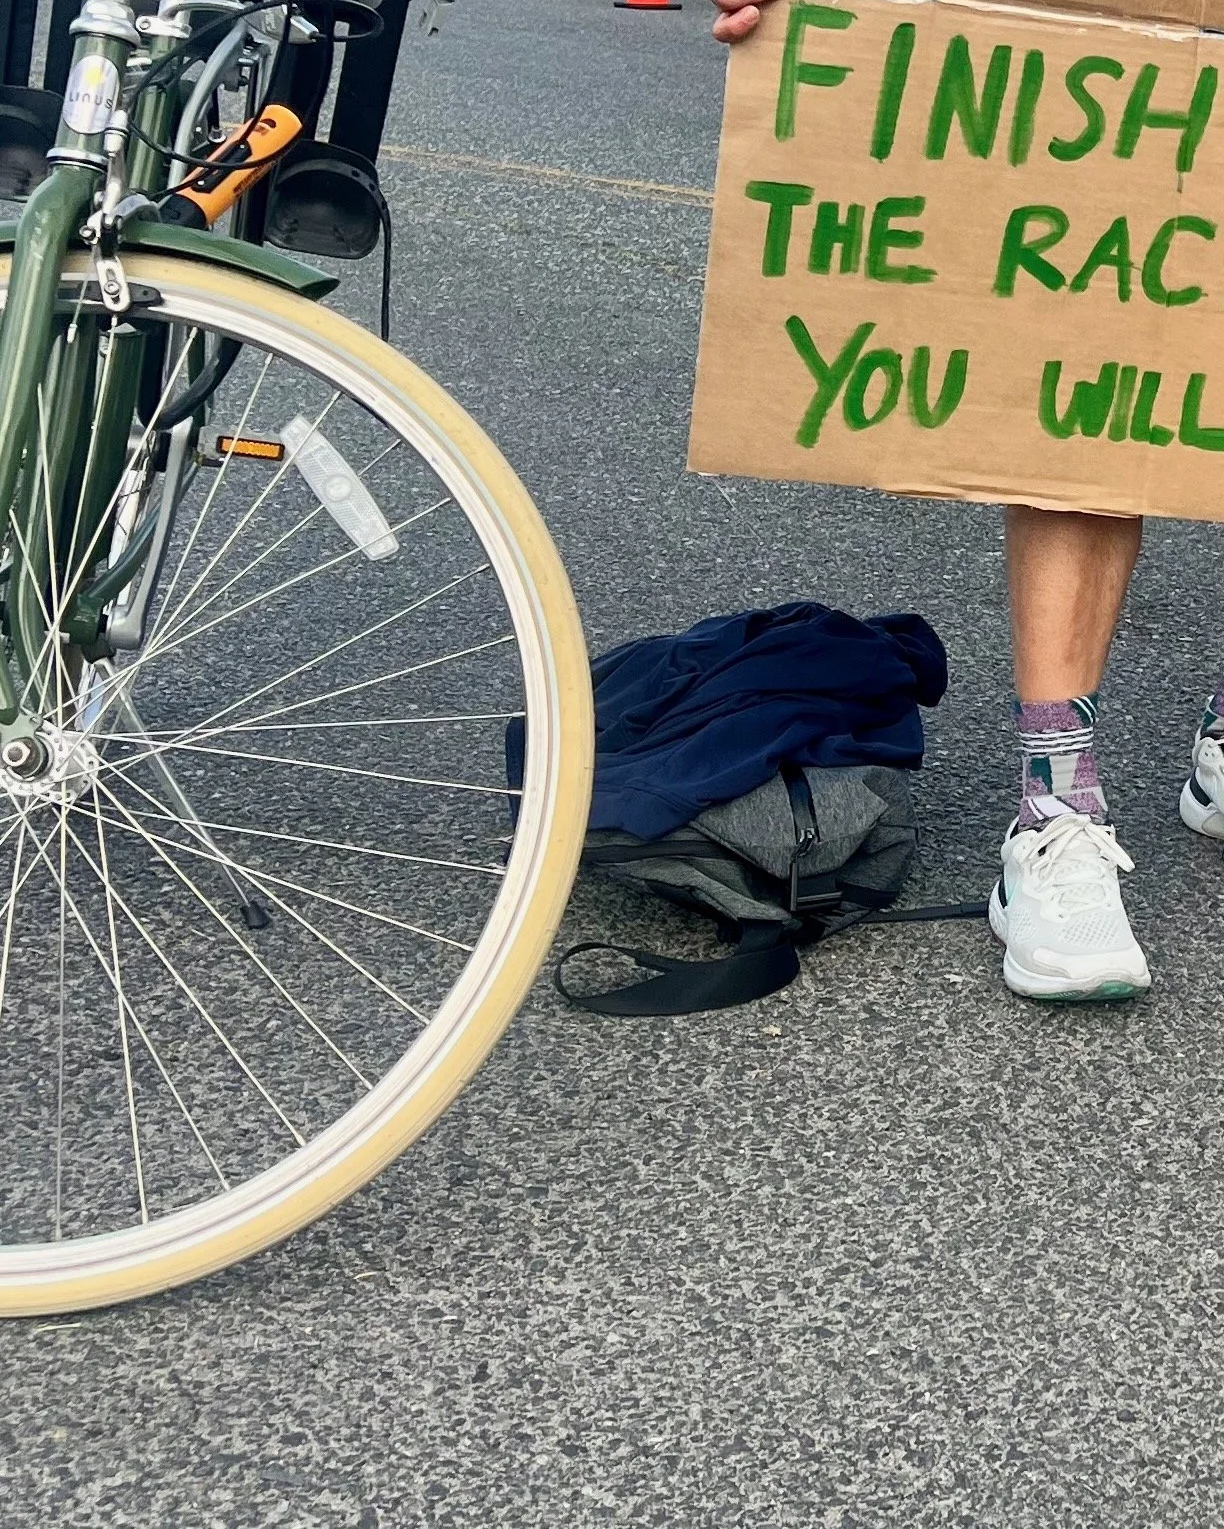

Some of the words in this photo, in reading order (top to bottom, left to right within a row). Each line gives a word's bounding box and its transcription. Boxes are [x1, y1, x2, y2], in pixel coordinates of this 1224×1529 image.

[774, 1, 1218, 182] FINISH
[745, 181, 936, 283] THE
[784, 315, 968, 450] YOU
